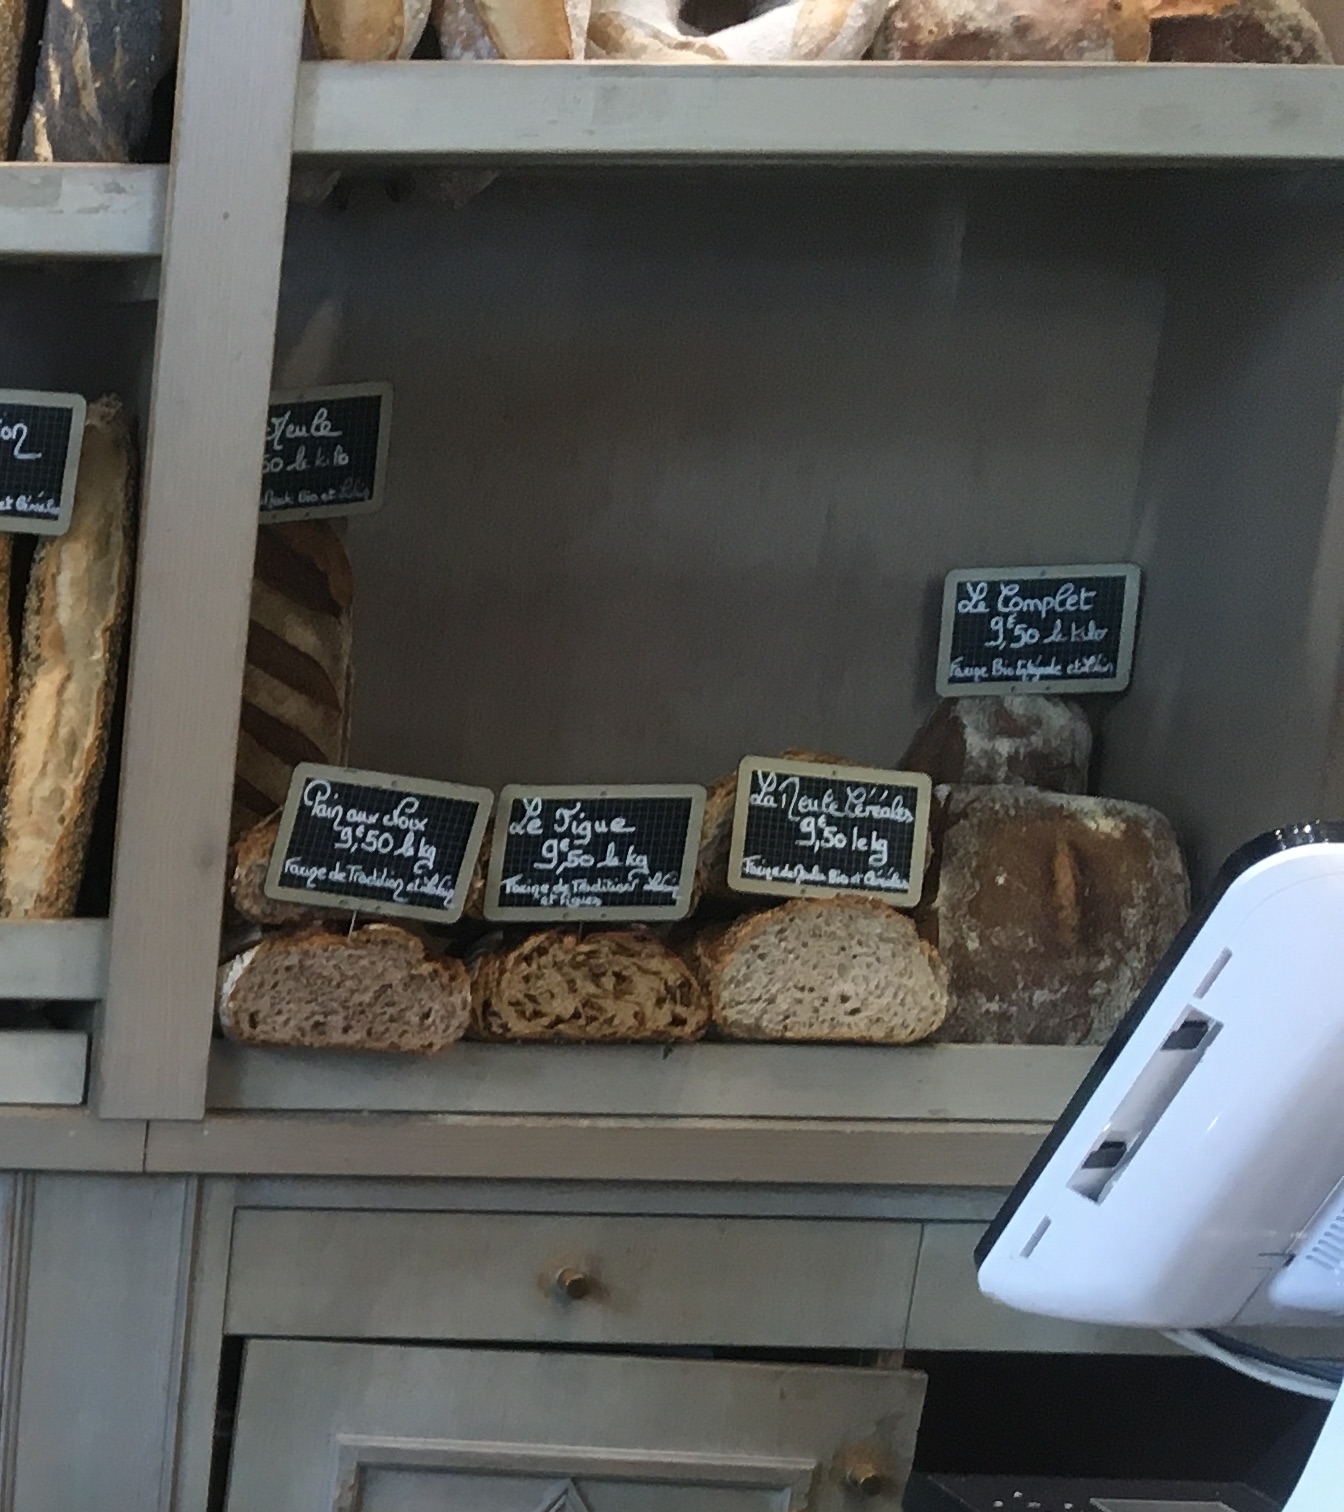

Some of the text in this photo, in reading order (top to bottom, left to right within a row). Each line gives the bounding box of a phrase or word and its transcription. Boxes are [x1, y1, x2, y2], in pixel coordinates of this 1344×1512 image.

[997, 582, 1097, 618] Complet
[303, 779, 343, 830] Pain
[346, 808, 380, 824] aux
[413, 836, 437, 874] kg
[852, 826, 868, 852] le
[328, 861, 346, 882] de
[626, 845, 650, 881] kg
